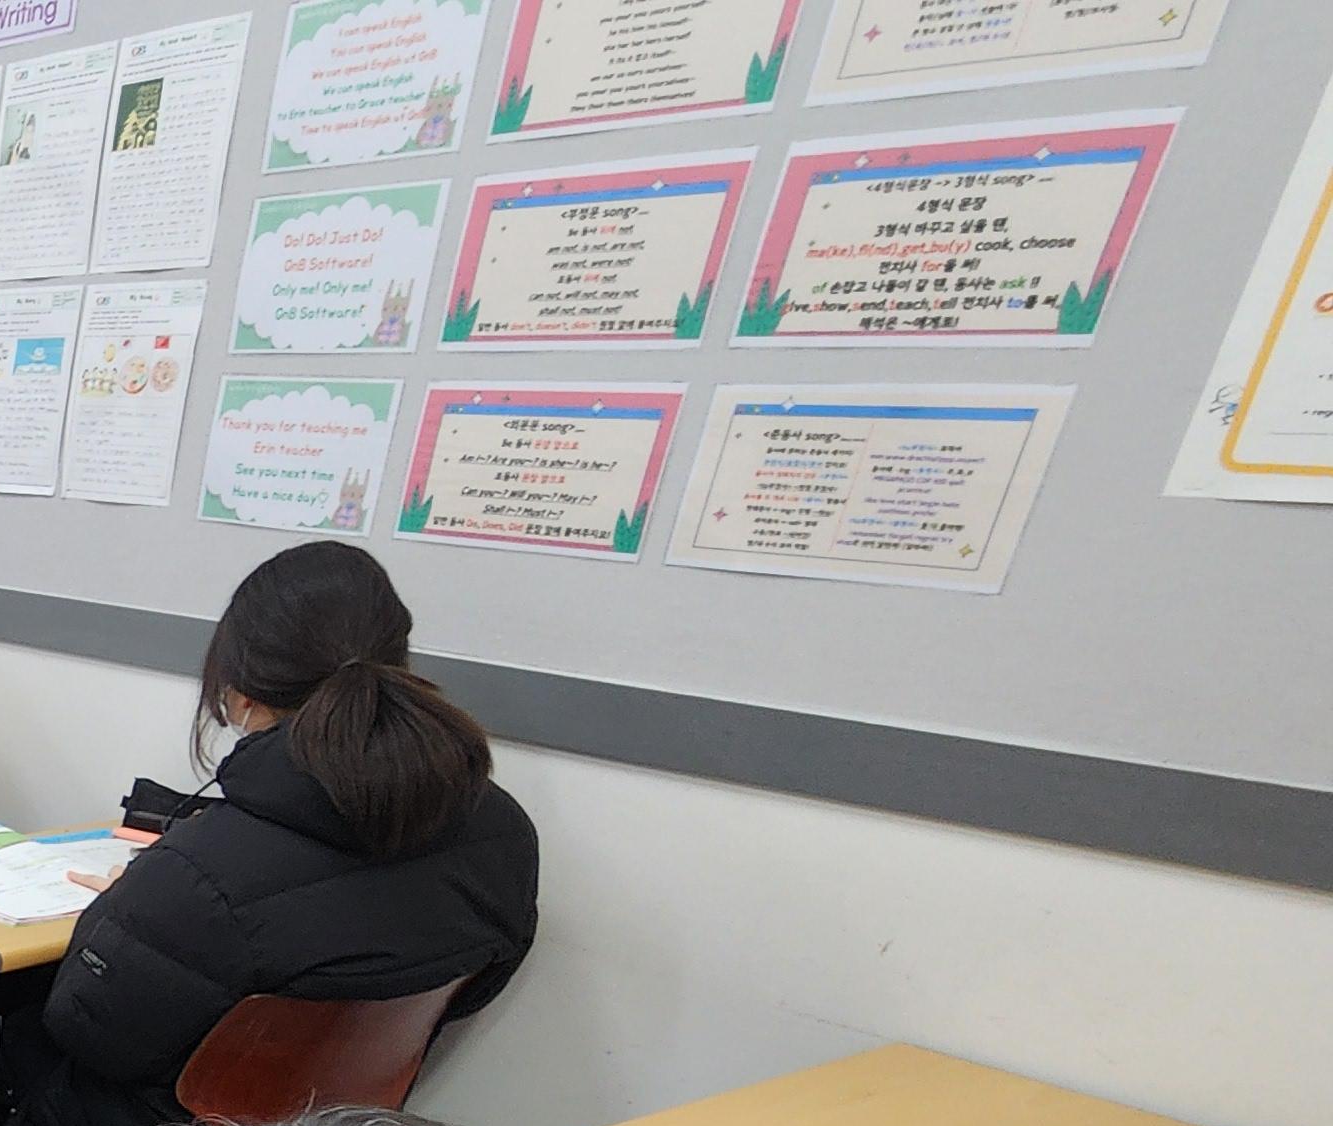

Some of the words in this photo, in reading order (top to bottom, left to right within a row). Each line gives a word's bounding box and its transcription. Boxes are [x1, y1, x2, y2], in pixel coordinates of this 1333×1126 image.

[330, 232, 358, 245] Just
[974, 238, 1014, 252] cook,
[1019, 235, 1077, 250] choose
[272, 282, 297, 297] Only
[323, 281, 349, 296] Only
[998, 275, 1028, 290] ask
[222, 417, 252, 430] Thank
[255, 422, 274, 434] you
[279, 420, 297, 433] for
[301, 422, 349, 437] teaching
[352, 426, 368, 436] me
[253, 441, 276, 455] Erin
[279, 445, 324, 457] teacher
[235, 463, 255, 475] See
[258, 467, 278, 479] you
[281, 468, 307, 480] next
[311, 470, 334, 482] time
[233, 487, 259, 499] Have
[272, 491, 294, 501] nice
